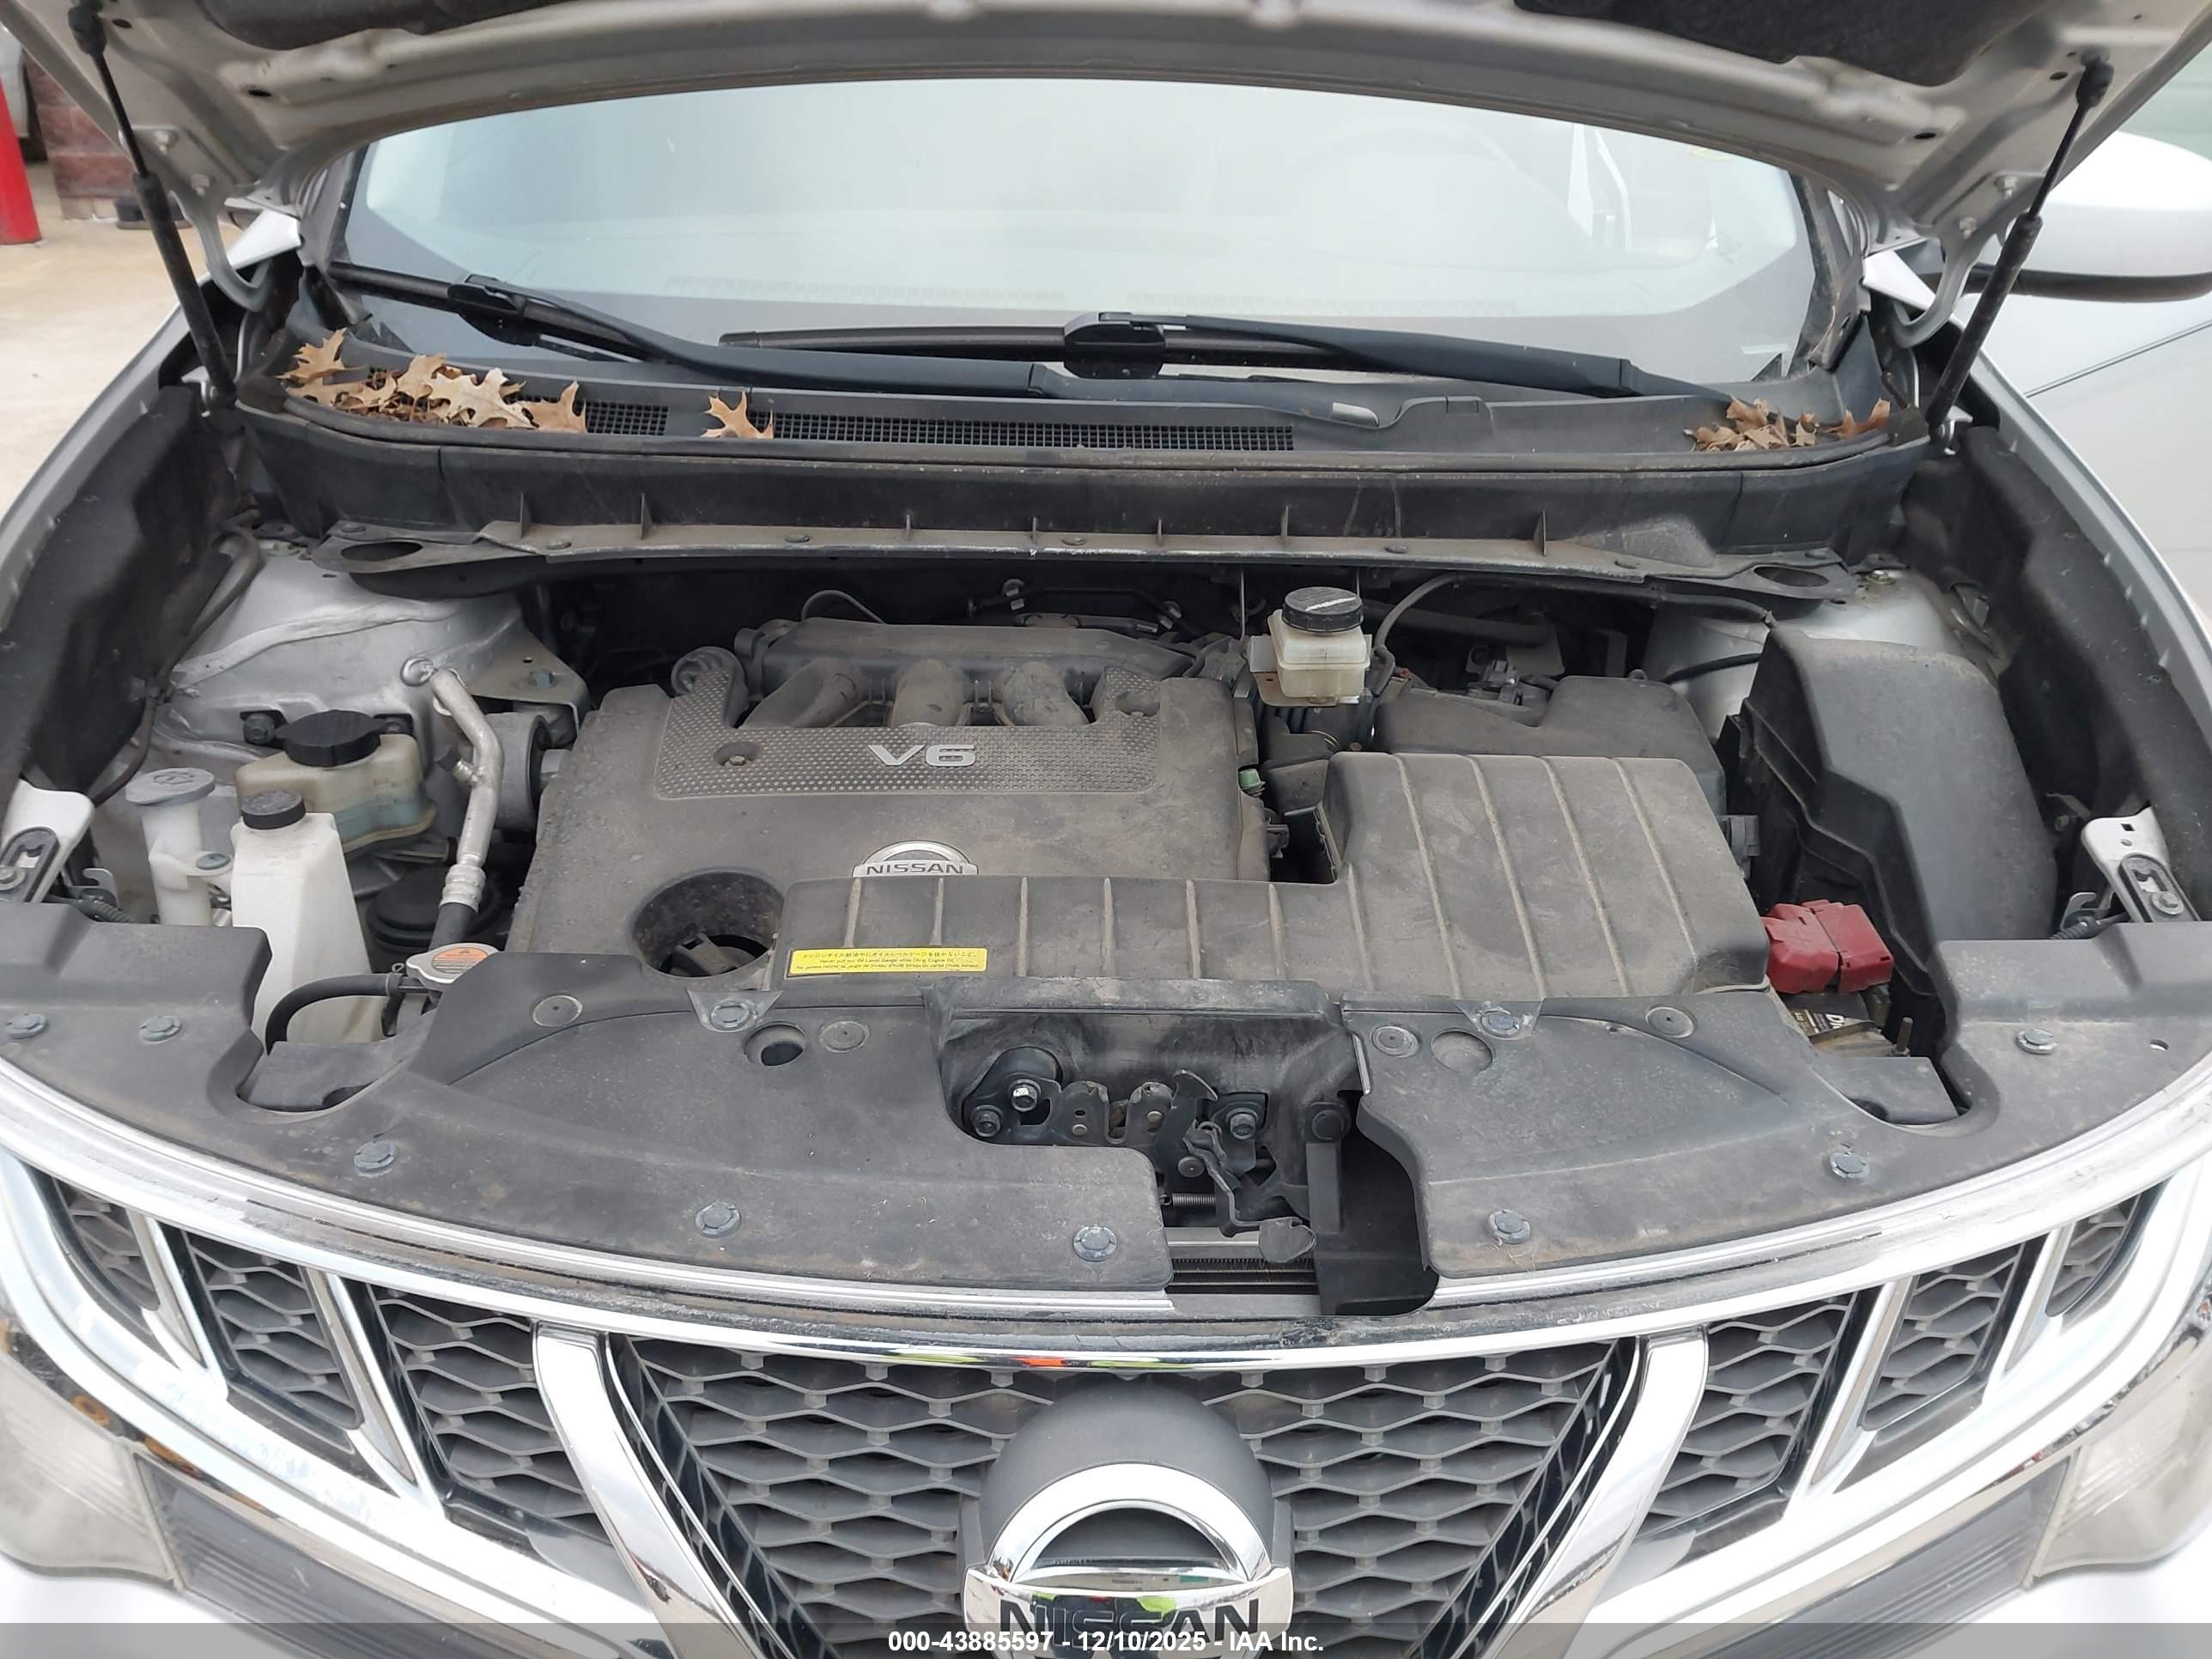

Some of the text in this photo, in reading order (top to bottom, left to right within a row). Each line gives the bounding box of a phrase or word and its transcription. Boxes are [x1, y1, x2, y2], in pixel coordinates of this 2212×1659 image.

[867, 744, 976, 767] V6
[866, 863, 963, 875] NISSAN
[1000, 1599, 1260, 1648] NISSAN
